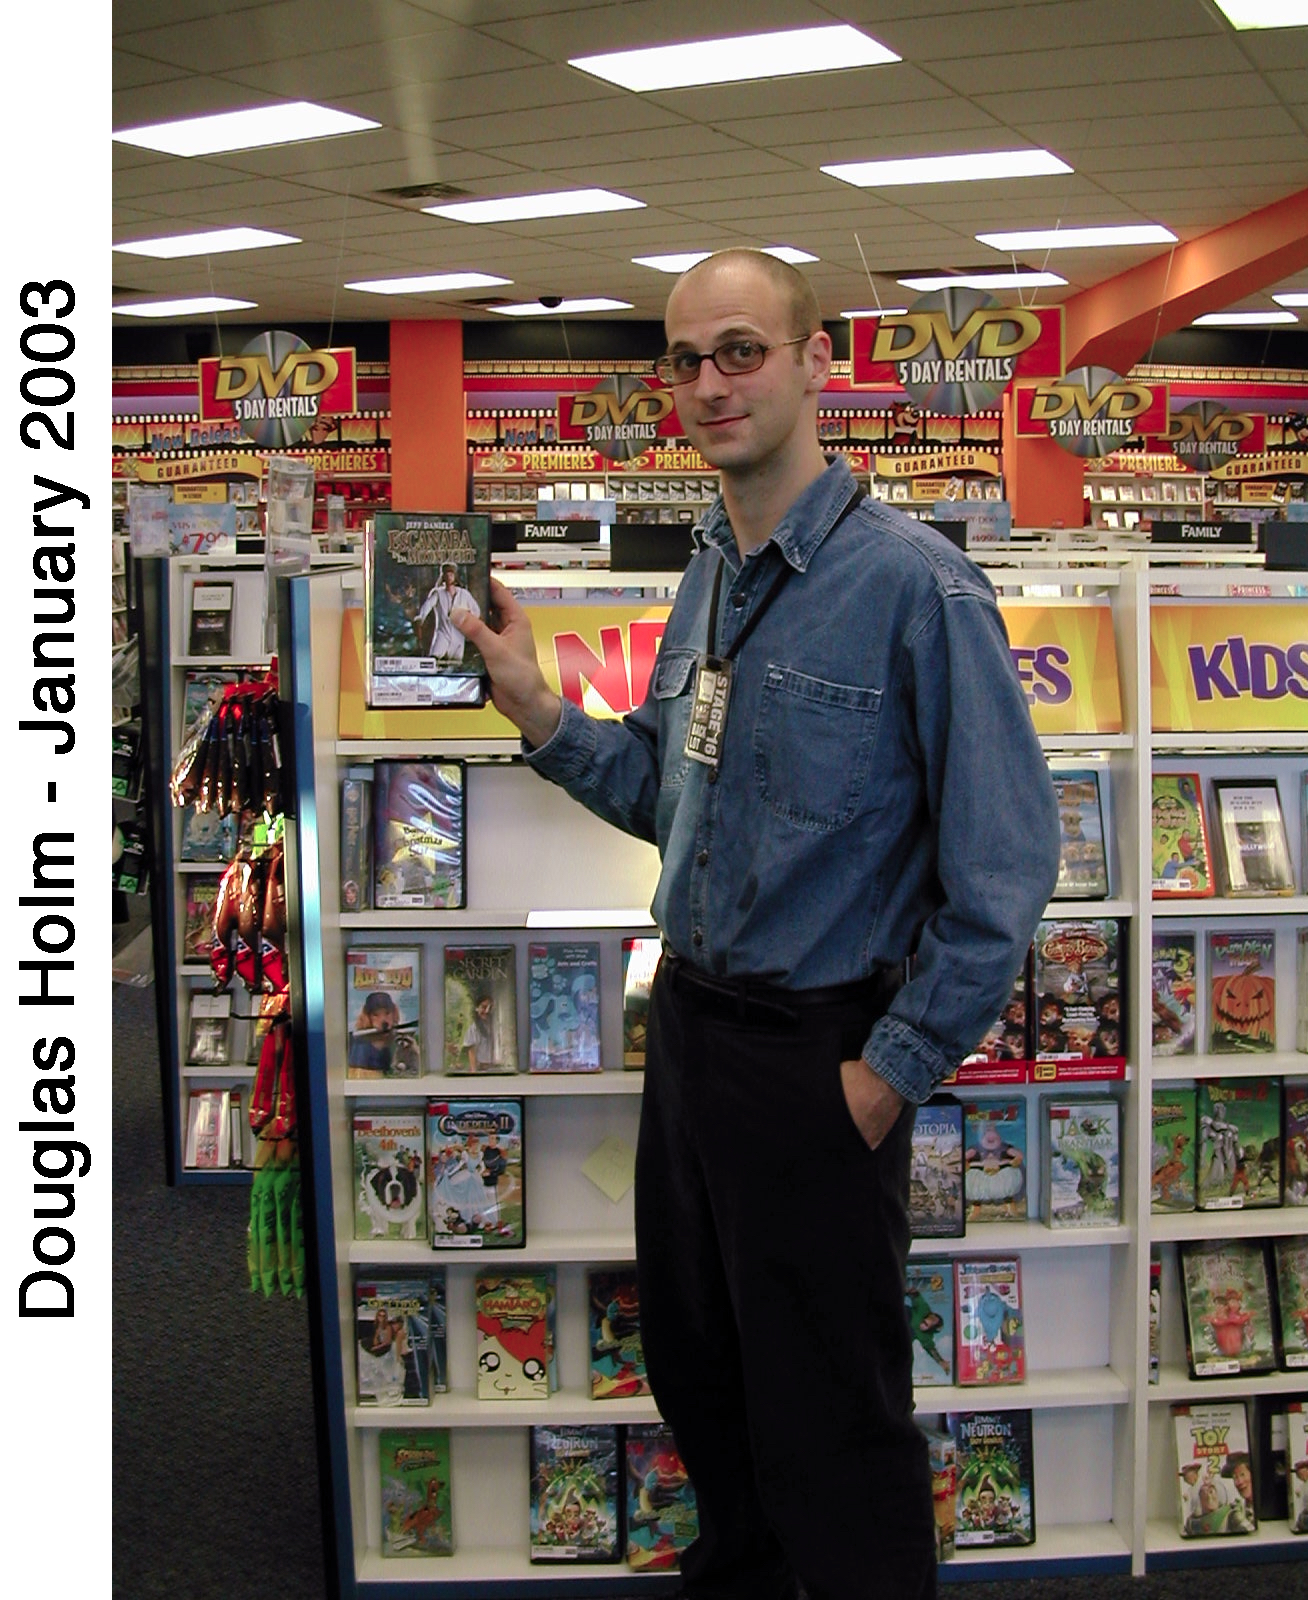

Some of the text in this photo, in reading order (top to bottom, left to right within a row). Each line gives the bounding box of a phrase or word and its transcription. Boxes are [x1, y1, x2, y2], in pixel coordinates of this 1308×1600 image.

[872, 308, 1042, 363] DVD
[214, 352, 339, 401] DVD
[899, 358, 1013, 384] 5 DAY RENTALS
[235, 396, 319, 420] 5 DAY RENTALS
[570, 391, 674, 426] DVD
[1030, 385, 1154, 420] DVD
[587, 423, 657, 442] 5 DAY RENTALS
[1050, 419, 1133, 437] 5 DAY RENTALS
[1157, 414, 1255, 442] DVD
[1173, 441, 1239, 455] 5 DAY RENTALS
[157, 458, 239, 479] GUARANTEED
[481, 453, 595, 471] DVD PREMIERES
[895, 455, 975, 474] GUARANTEED
[1226, 458, 1301, 476] GUARANTEED
[405, 521, 455, 530] JEFF DANIELS
[524, 524, 568, 538] FAMILY
[1181, 524, 1223, 539] FAMILY
[388, 530, 473, 552] ESCANABA
[1187, 635, 1308, 702] KIDS
[913, 1122, 958, 1137] OTOPIA
[960, 1422, 1013, 1439] NEUTRON
[1190, 1425, 1231, 1447] TOY
[1207, 1454, 1221, 1474] 2
